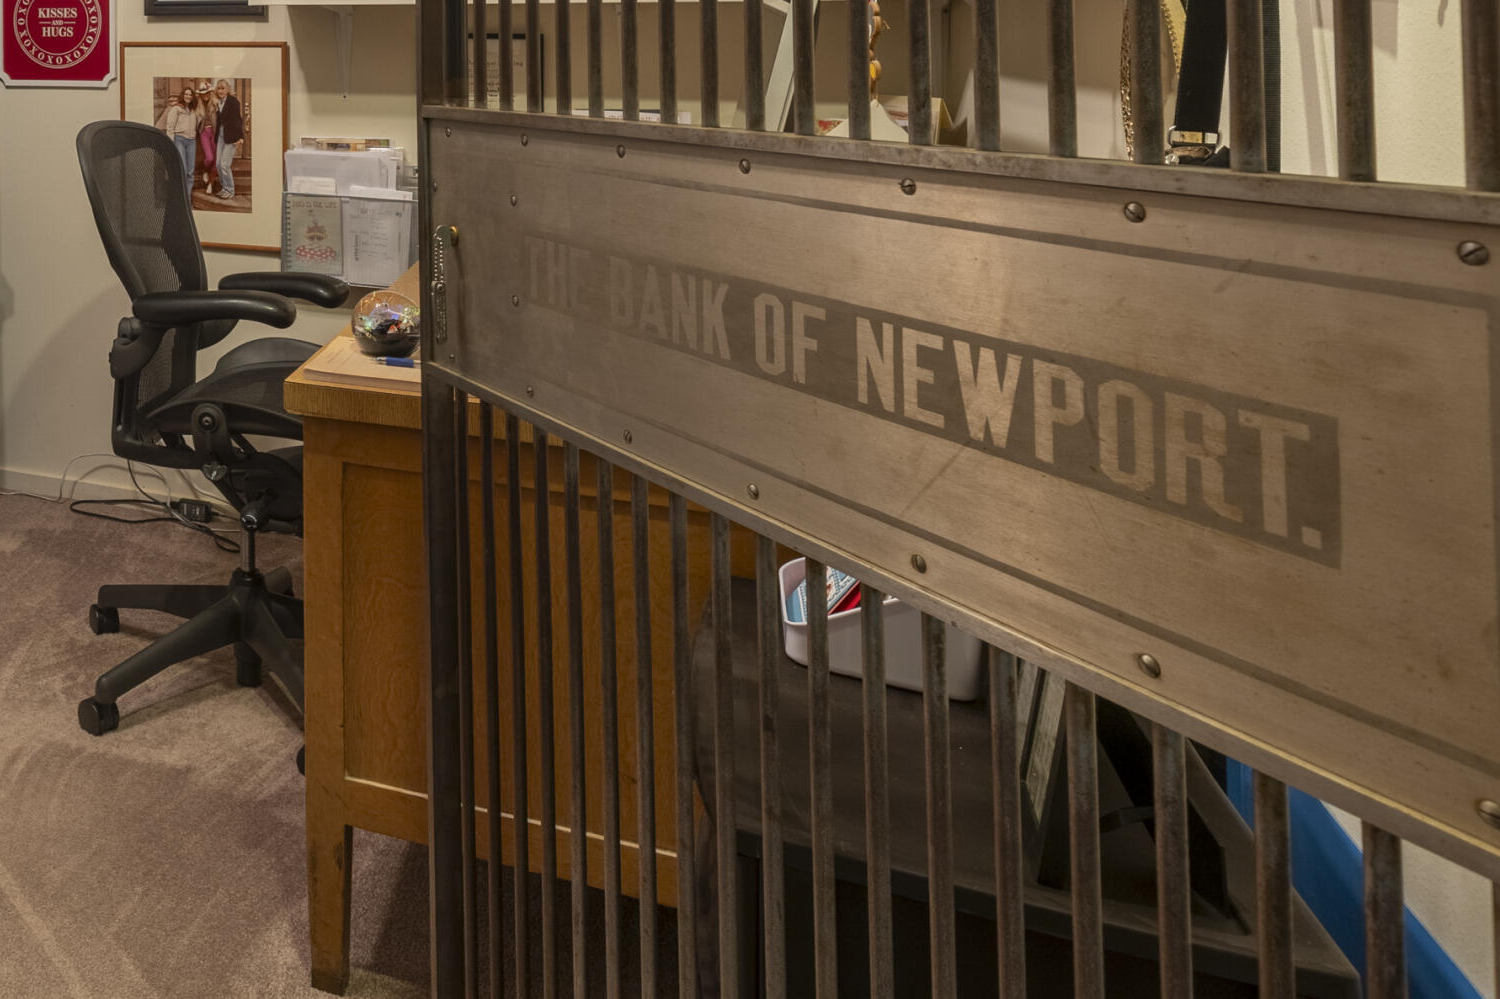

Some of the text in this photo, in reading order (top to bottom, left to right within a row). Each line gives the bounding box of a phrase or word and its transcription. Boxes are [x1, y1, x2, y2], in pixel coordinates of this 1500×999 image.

[37, 7, 78, 19] KISSES
[42, 26, 74, 38] HUGS
[609, 255, 731, 361] BANK
[753, 292, 827, 385] OF
[855, 316, 1323, 550] NEWPORT.
